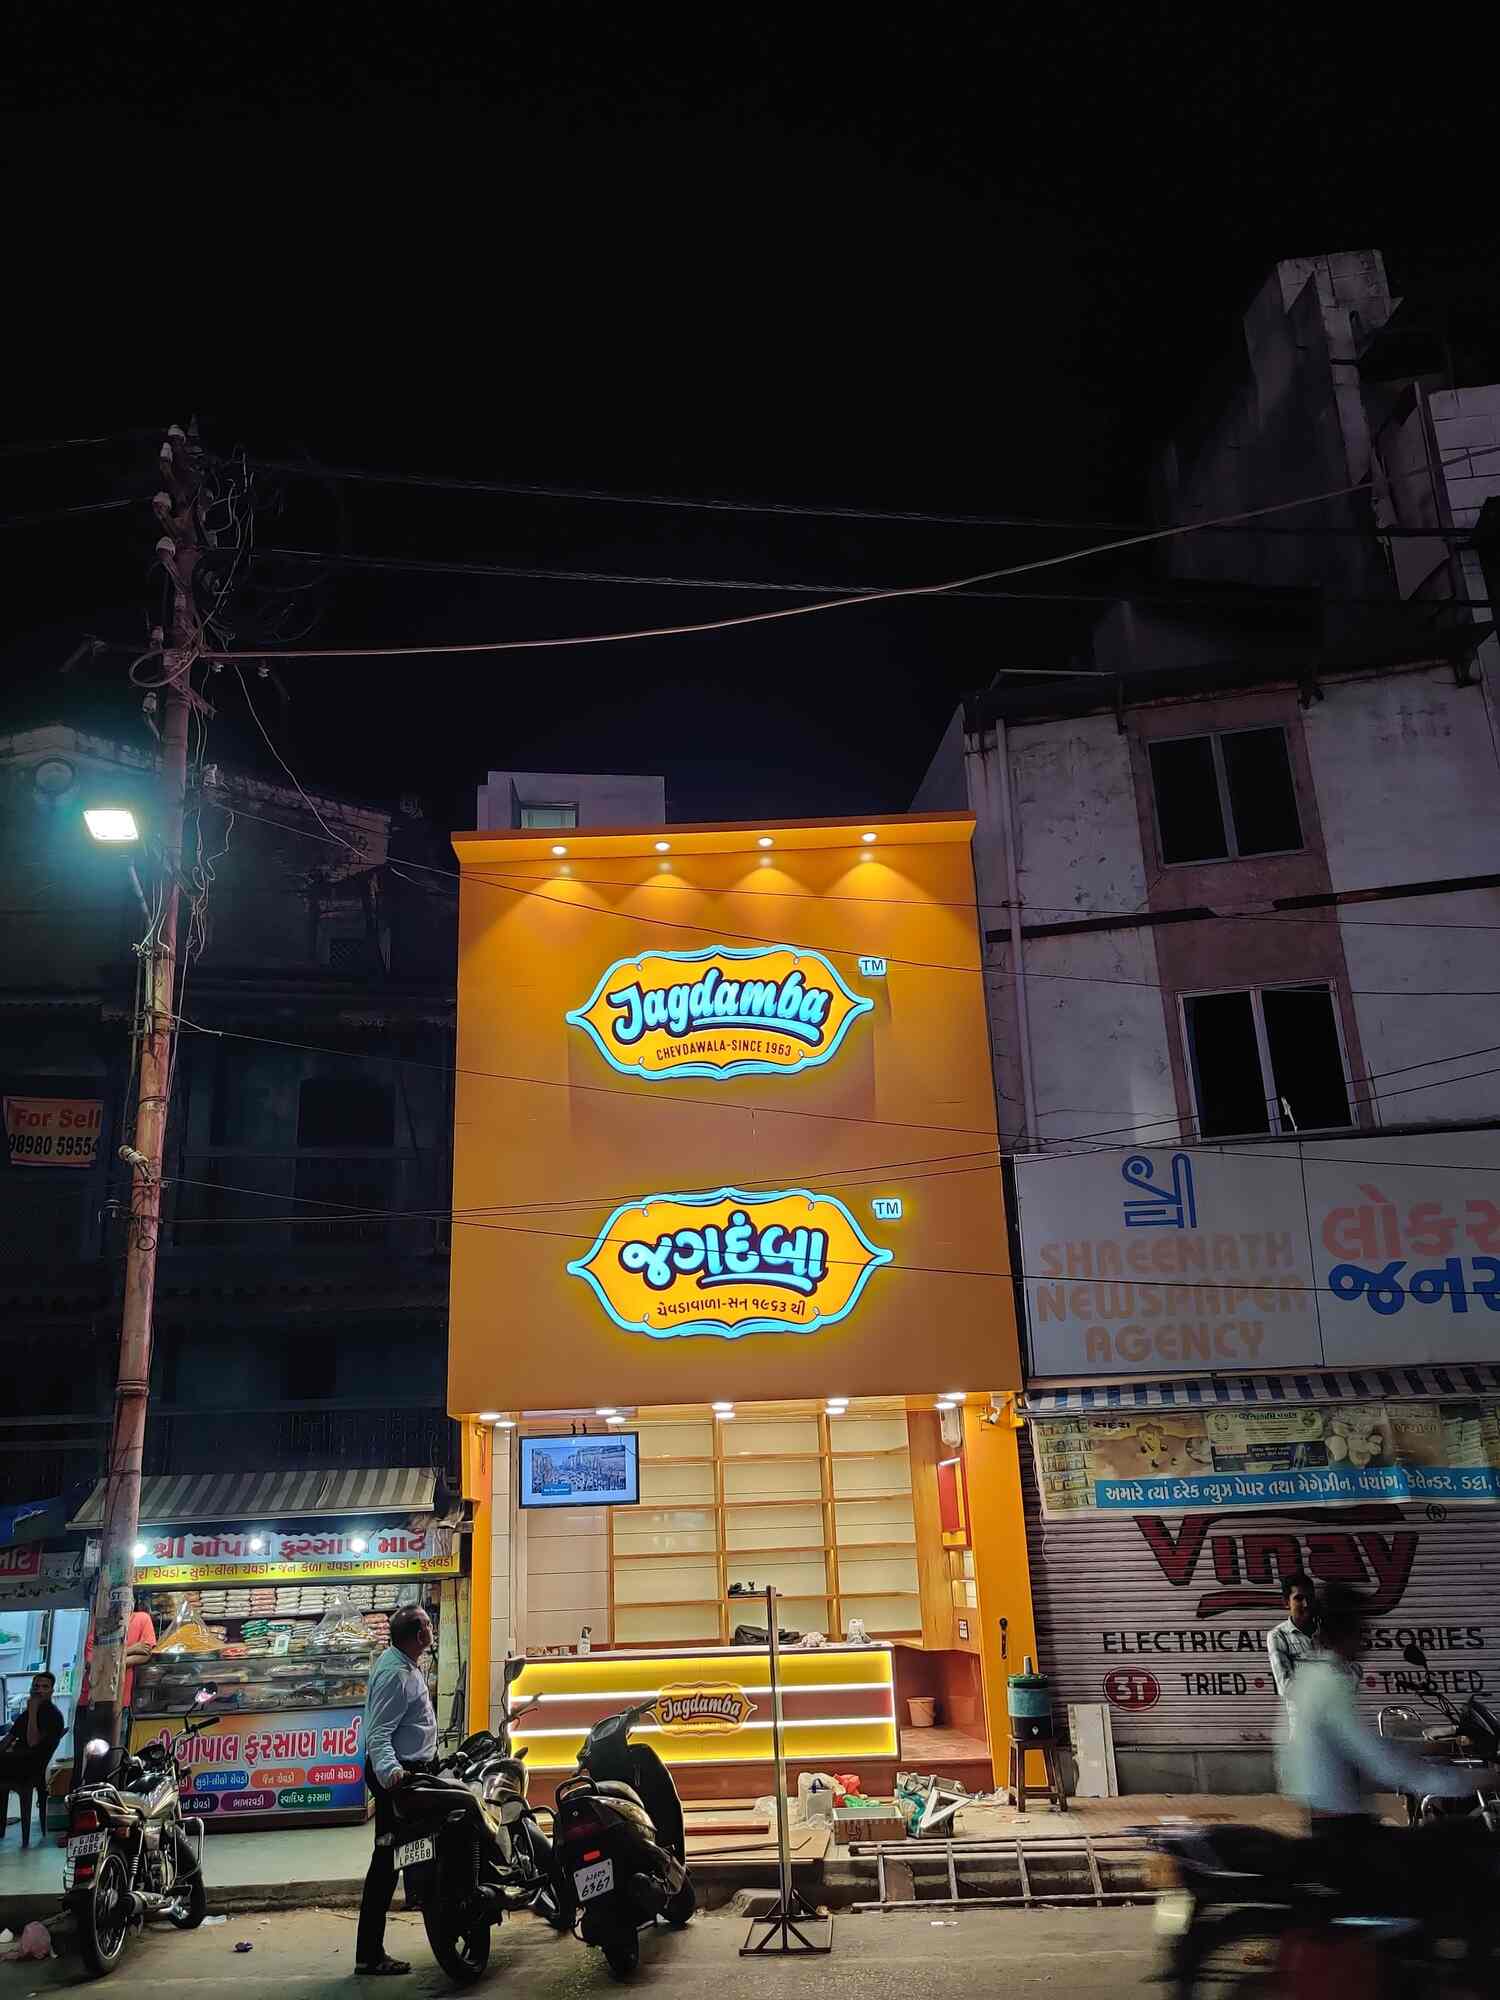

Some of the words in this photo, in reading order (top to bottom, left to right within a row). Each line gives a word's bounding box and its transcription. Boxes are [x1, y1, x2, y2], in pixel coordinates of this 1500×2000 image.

[862, 959, 884, 971] TM
[606, 967, 833, 1045] Jagdamba
[765, 1041, 792, 1057] 1963
[16, 1108, 55, 1128] For
[8, 1134, 52, 1155] 98980
[876, 1202, 899, 1216] TM
[619, 1210, 829, 1289] જગદંબા
[1039, 1232, 1295, 1277] SHREENATH
[1036, 1275, 1307, 1323] NEWSPAPER
[1085, 1320, 1265, 1363] AGENCY
[1105, 1482, 1144, 1501] અમારે
[1173, 1479, 1200, 1498] દરેક
[1235, 1477, 1264, 1497] પેપર
[1268, 1478, 1295, 1496] તથા
[279, 1538, 370, 1561] ફરસા
[1102, 1629, 1268, 1654] ELECTRICAL
[1181, 1672, 1247, 1696] TRIED
[660, 1691, 742, 1723] Jagdamba
[322, 1715, 362, 1757] માર્ટ
